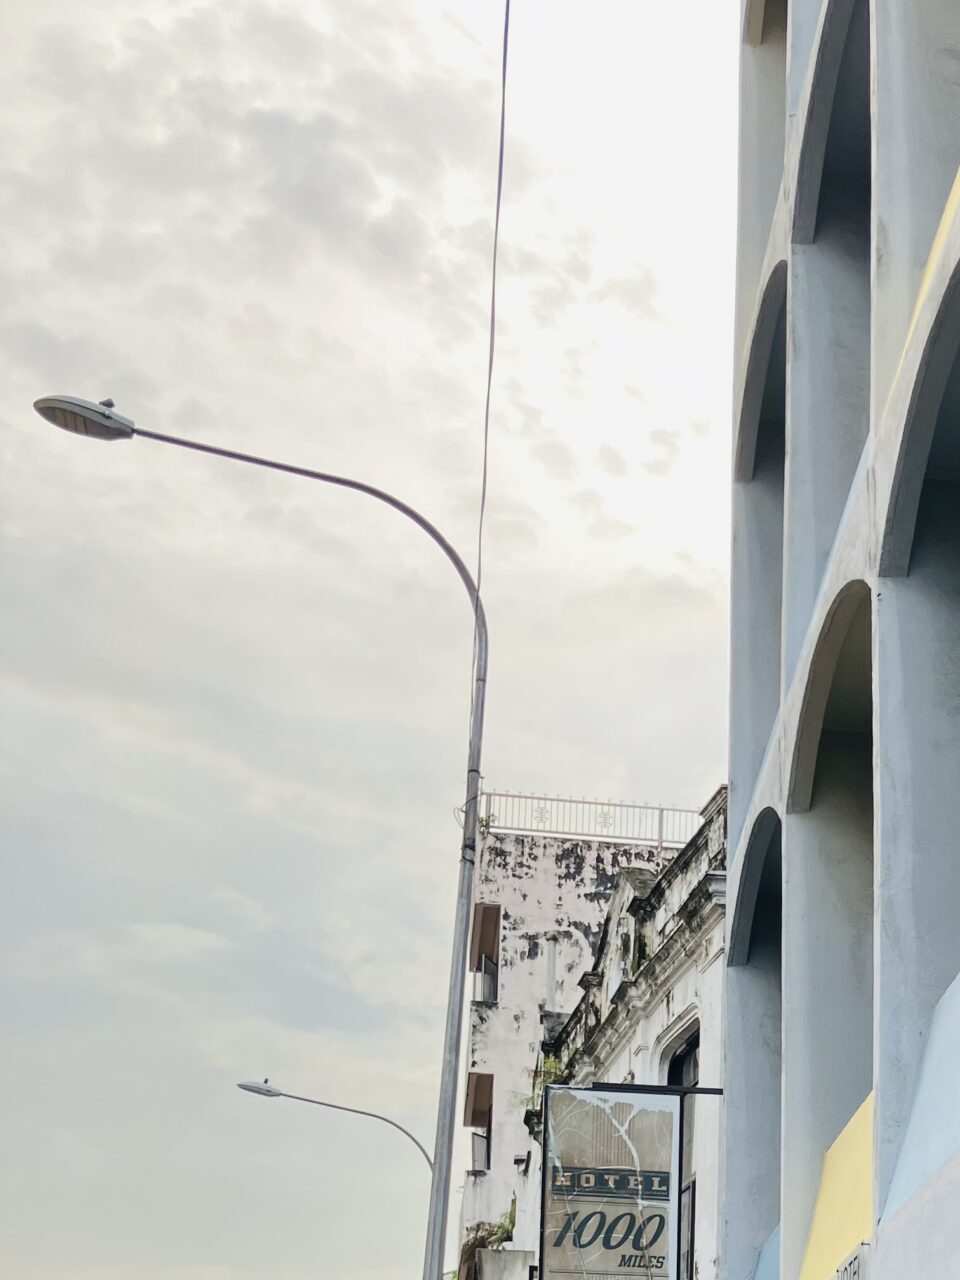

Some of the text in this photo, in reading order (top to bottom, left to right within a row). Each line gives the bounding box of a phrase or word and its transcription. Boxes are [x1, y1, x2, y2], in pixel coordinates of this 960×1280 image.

[554, 1172, 668, 1191] HOTEL
[552, 1210, 666, 1251] 1000
[617, 1254, 666, 1269] MILES
